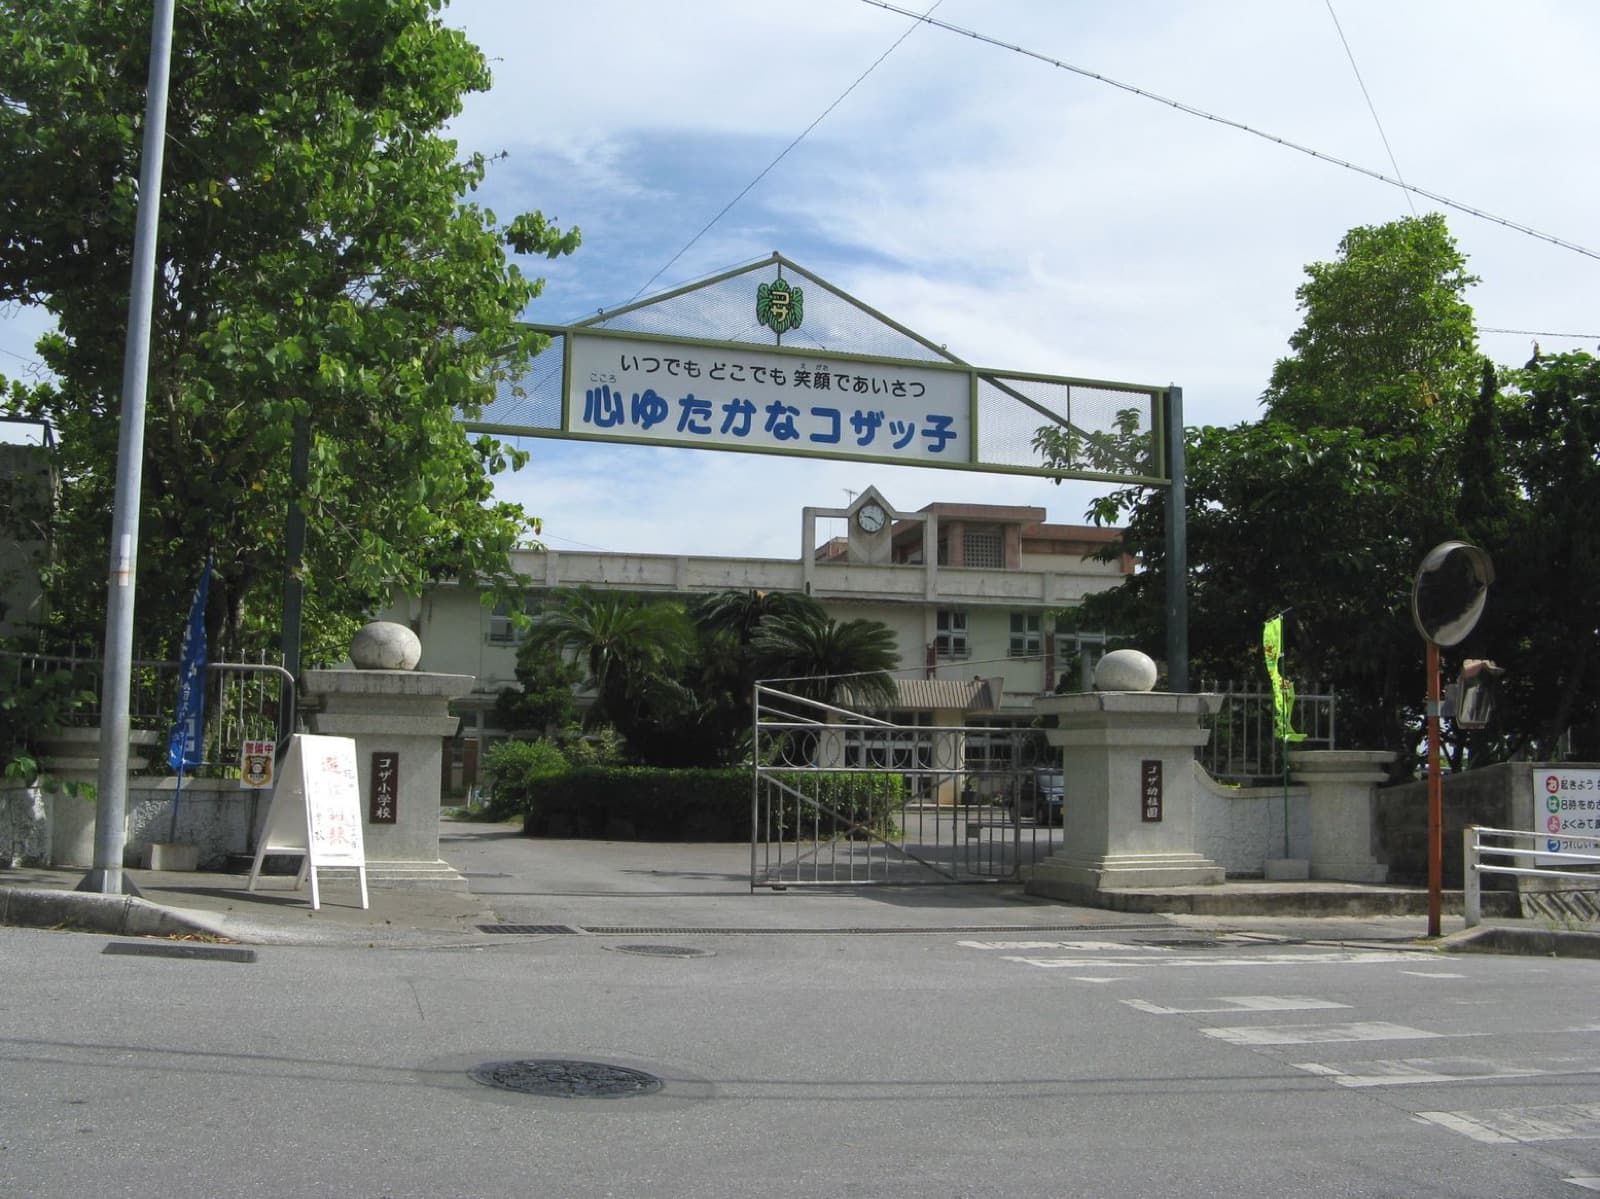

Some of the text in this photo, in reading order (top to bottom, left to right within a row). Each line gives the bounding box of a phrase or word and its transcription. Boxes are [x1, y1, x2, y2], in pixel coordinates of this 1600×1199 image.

[590, 372, 617, 384] こころ
[621, 354, 926, 398] いつでも どこでも 笑顔であいさつ
[583, 384, 957, 453] 心ゆたかなコザッ子
[376, 758, 393, 819] コザ小学校
